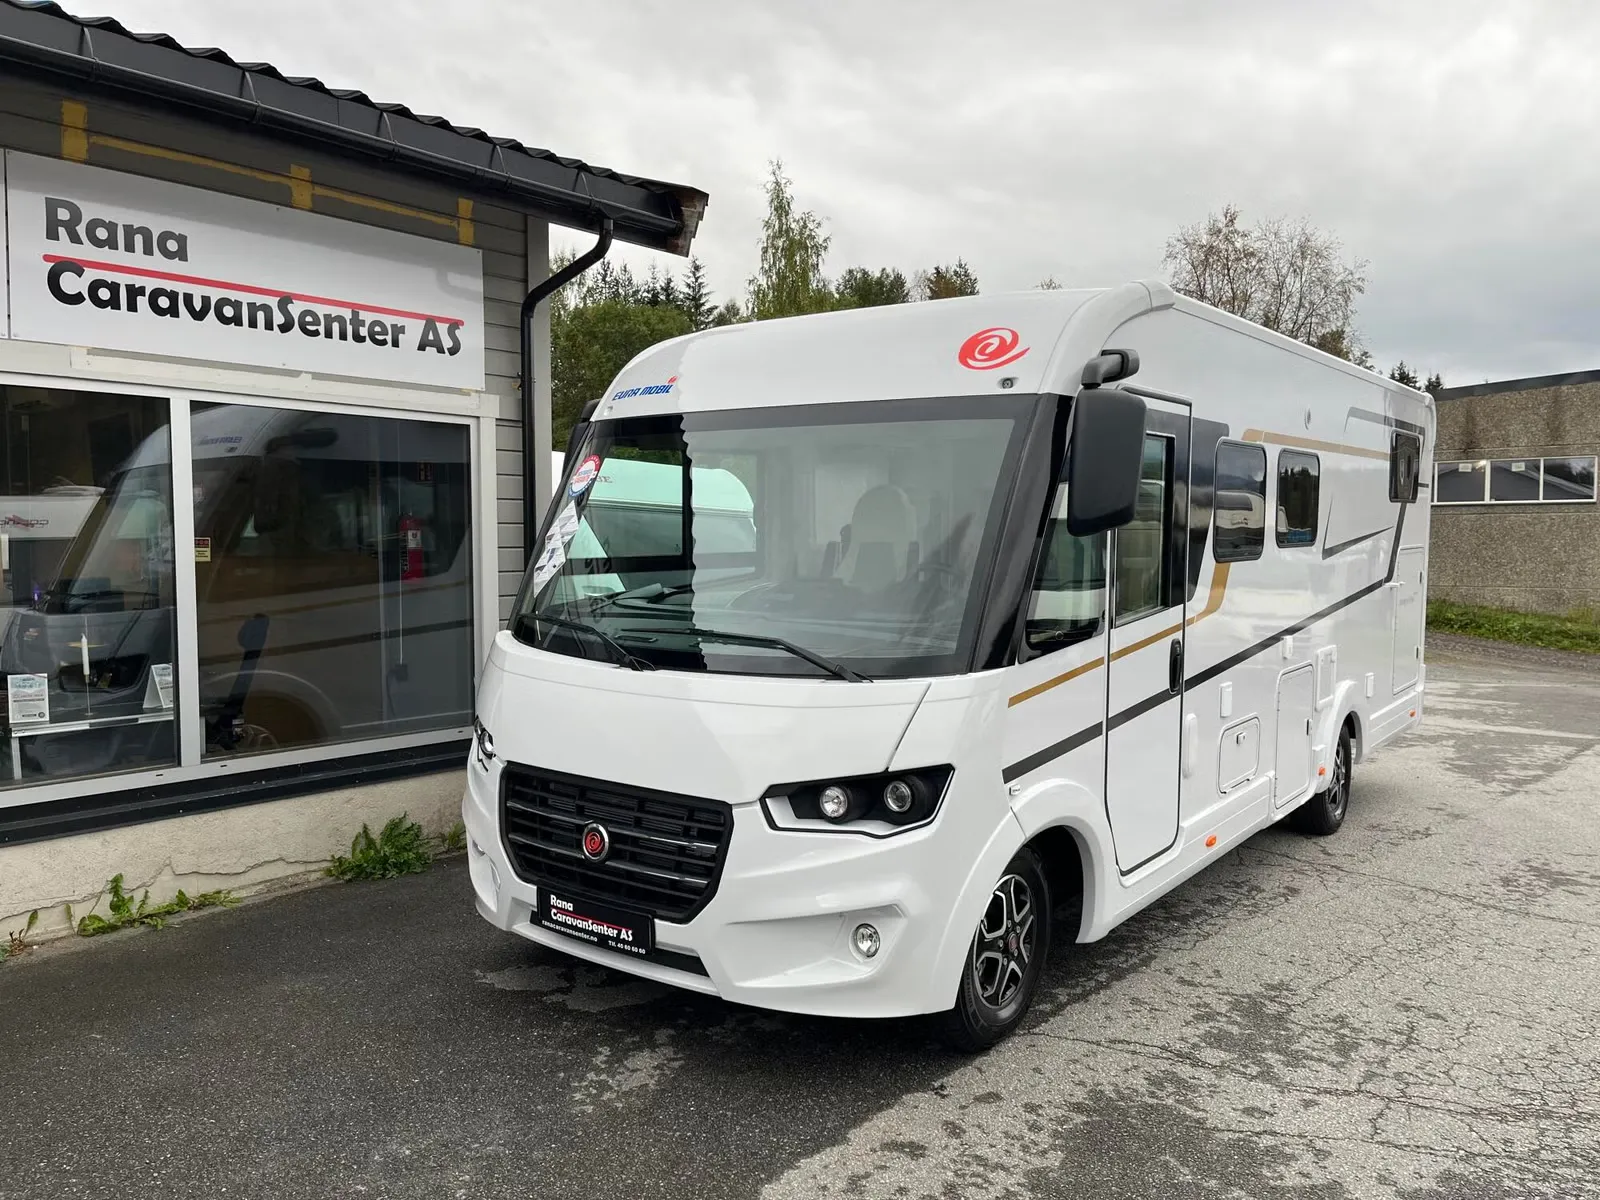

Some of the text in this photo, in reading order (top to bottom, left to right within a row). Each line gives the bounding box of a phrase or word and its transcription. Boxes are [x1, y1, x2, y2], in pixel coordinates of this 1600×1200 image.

[44, 197, 188, 262] Rana
[47, 260, 464, 357] CaravanSenter AS
[612, 384, 673, 402] EURA MOBIL
[550, 894, 573, 911] Rana
[542, 920, 597, 942] ranacaravansenter.no
[551, 909, 633, 941] CaravanSenter AS
